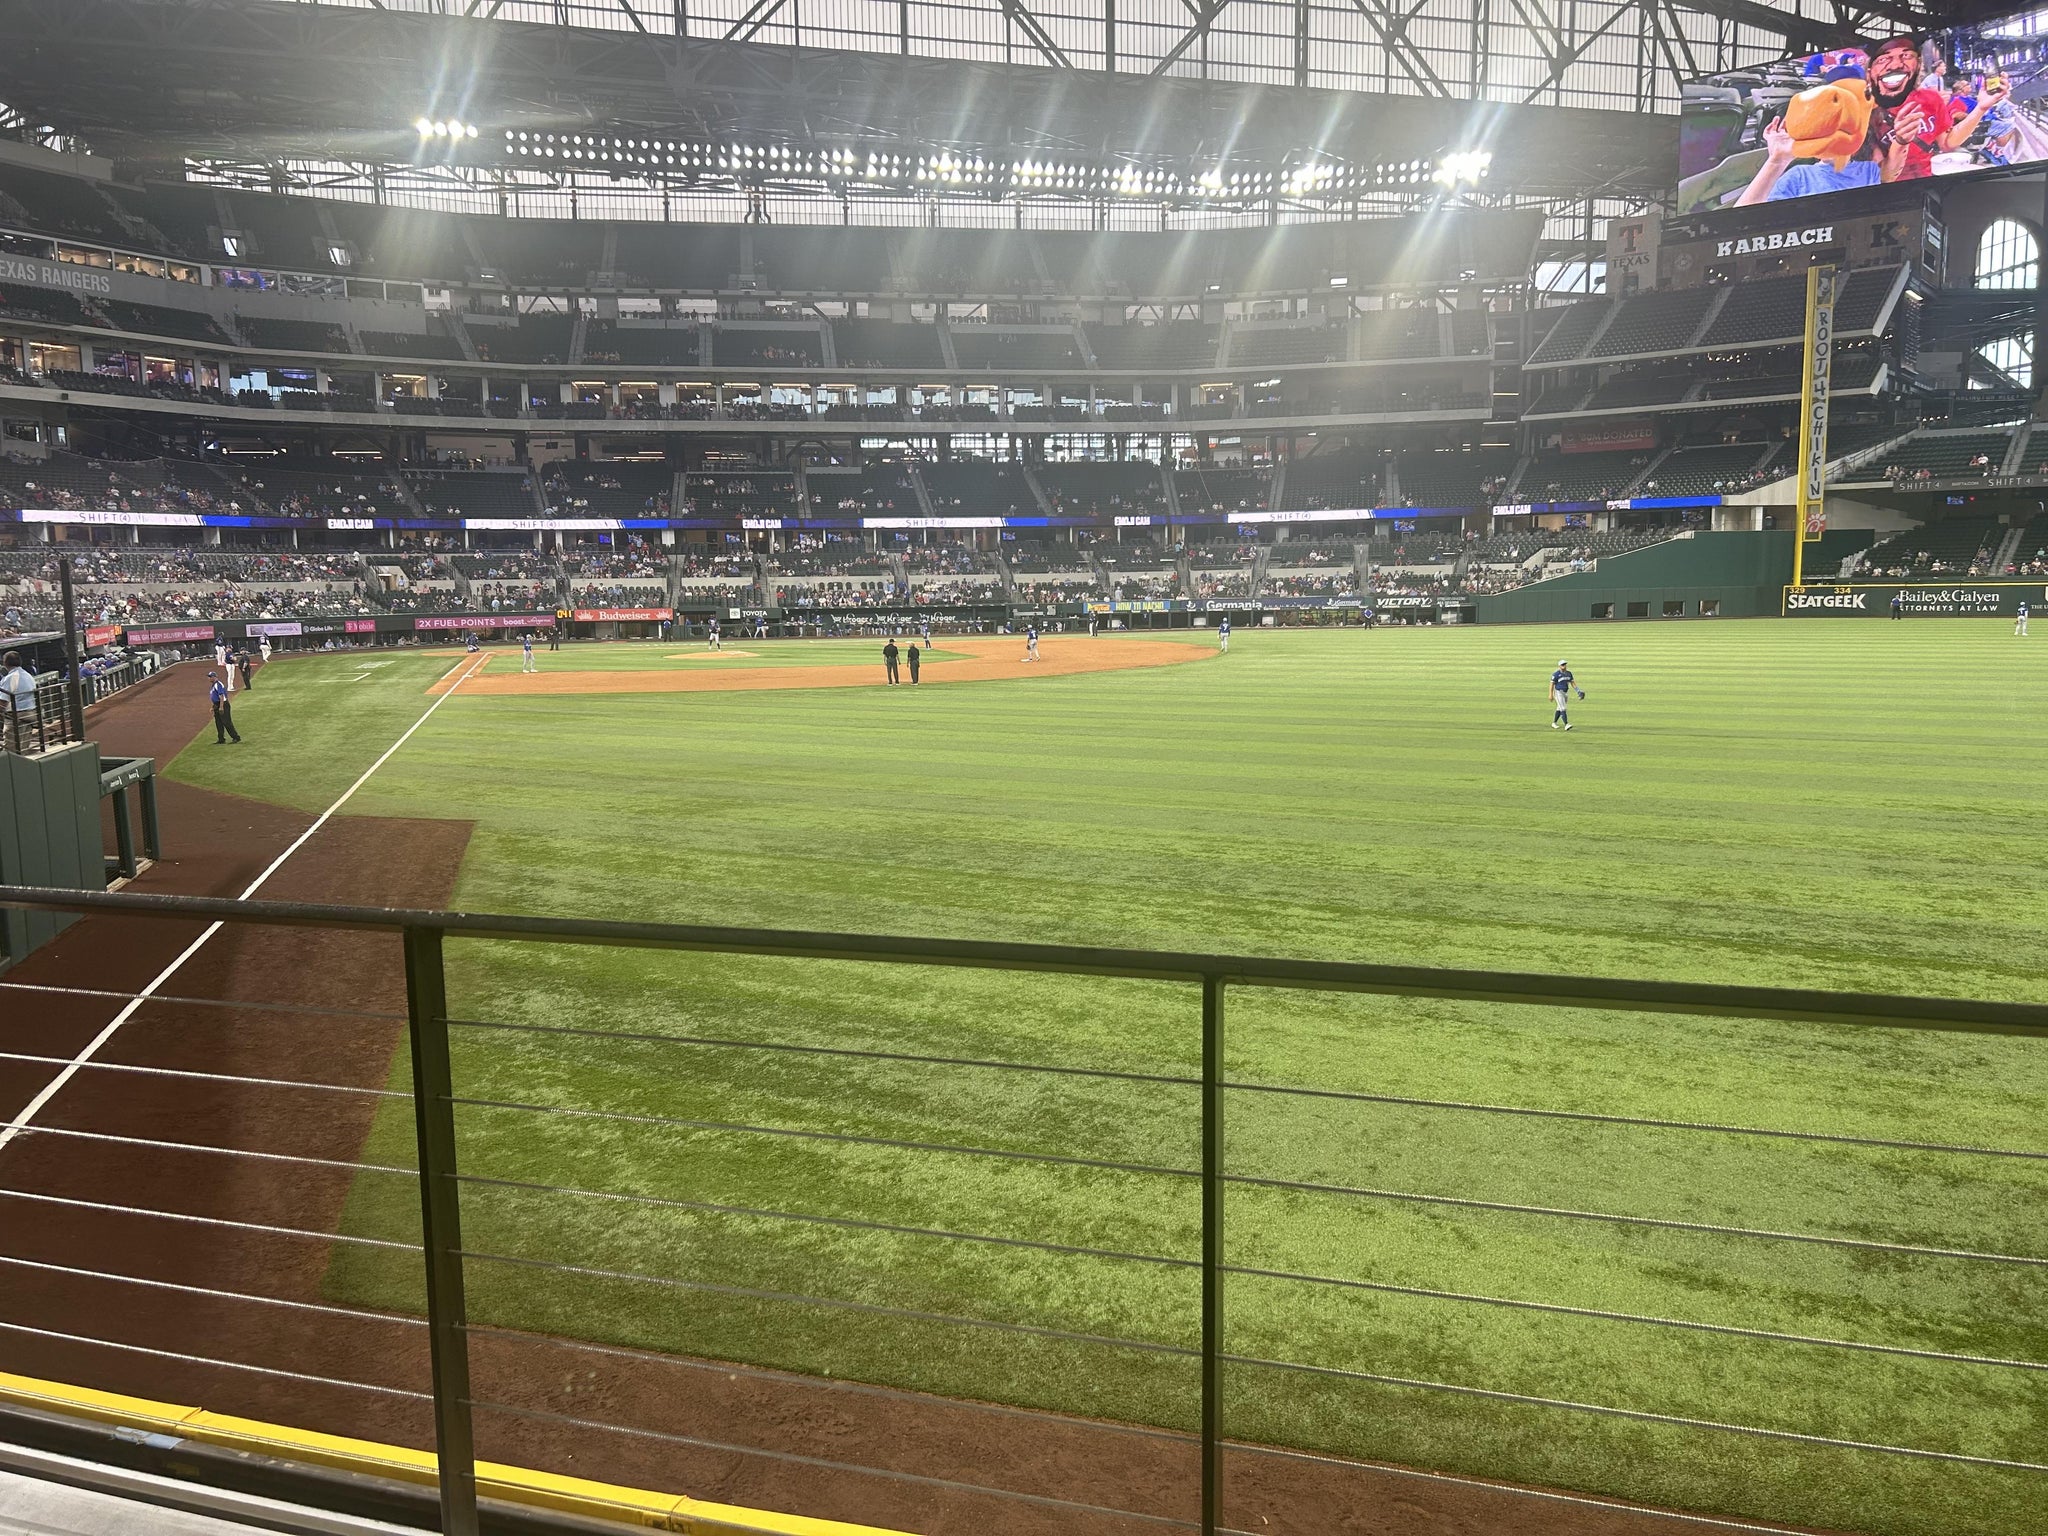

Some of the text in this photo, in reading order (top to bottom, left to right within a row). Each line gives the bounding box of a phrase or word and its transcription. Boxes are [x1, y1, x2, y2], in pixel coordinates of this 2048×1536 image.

[1880, 115, 1935, 144] TEAS
[1870, 221, 1899, 248] K
[1716, 226, 1833, 257] KARBACH
[1611, 254, 1650, 269] TEXAS
[41, 266, 110, 293] RANGERS
[1815, 311, 1828, 373] ROOT
[1602, 428, 1653, 440] DONATED
[1493, 504, 1531, 515] EMOJI CAM
[328, 519, 373, 529] EMOJI CAM
[743, 519, 781, 528] EMOJI CAM
[1115, 601, 1132, 610] HOW
[1133, 601, 1142, 610] TO
[1143, 601, 1164, 610] NACHO
[1206, 599, 1262, 609] Germania
[1376, 597, 1429, 606] VICTORY
[1787, 593, 1866, 609] SEATGEEK
[599, 611, 651, 620] Budweiser
[931, 613, 956, 622] Kroger
[461, 618, 496, 626] POINTS
[163, 631, 183, 639] DELIVERY
